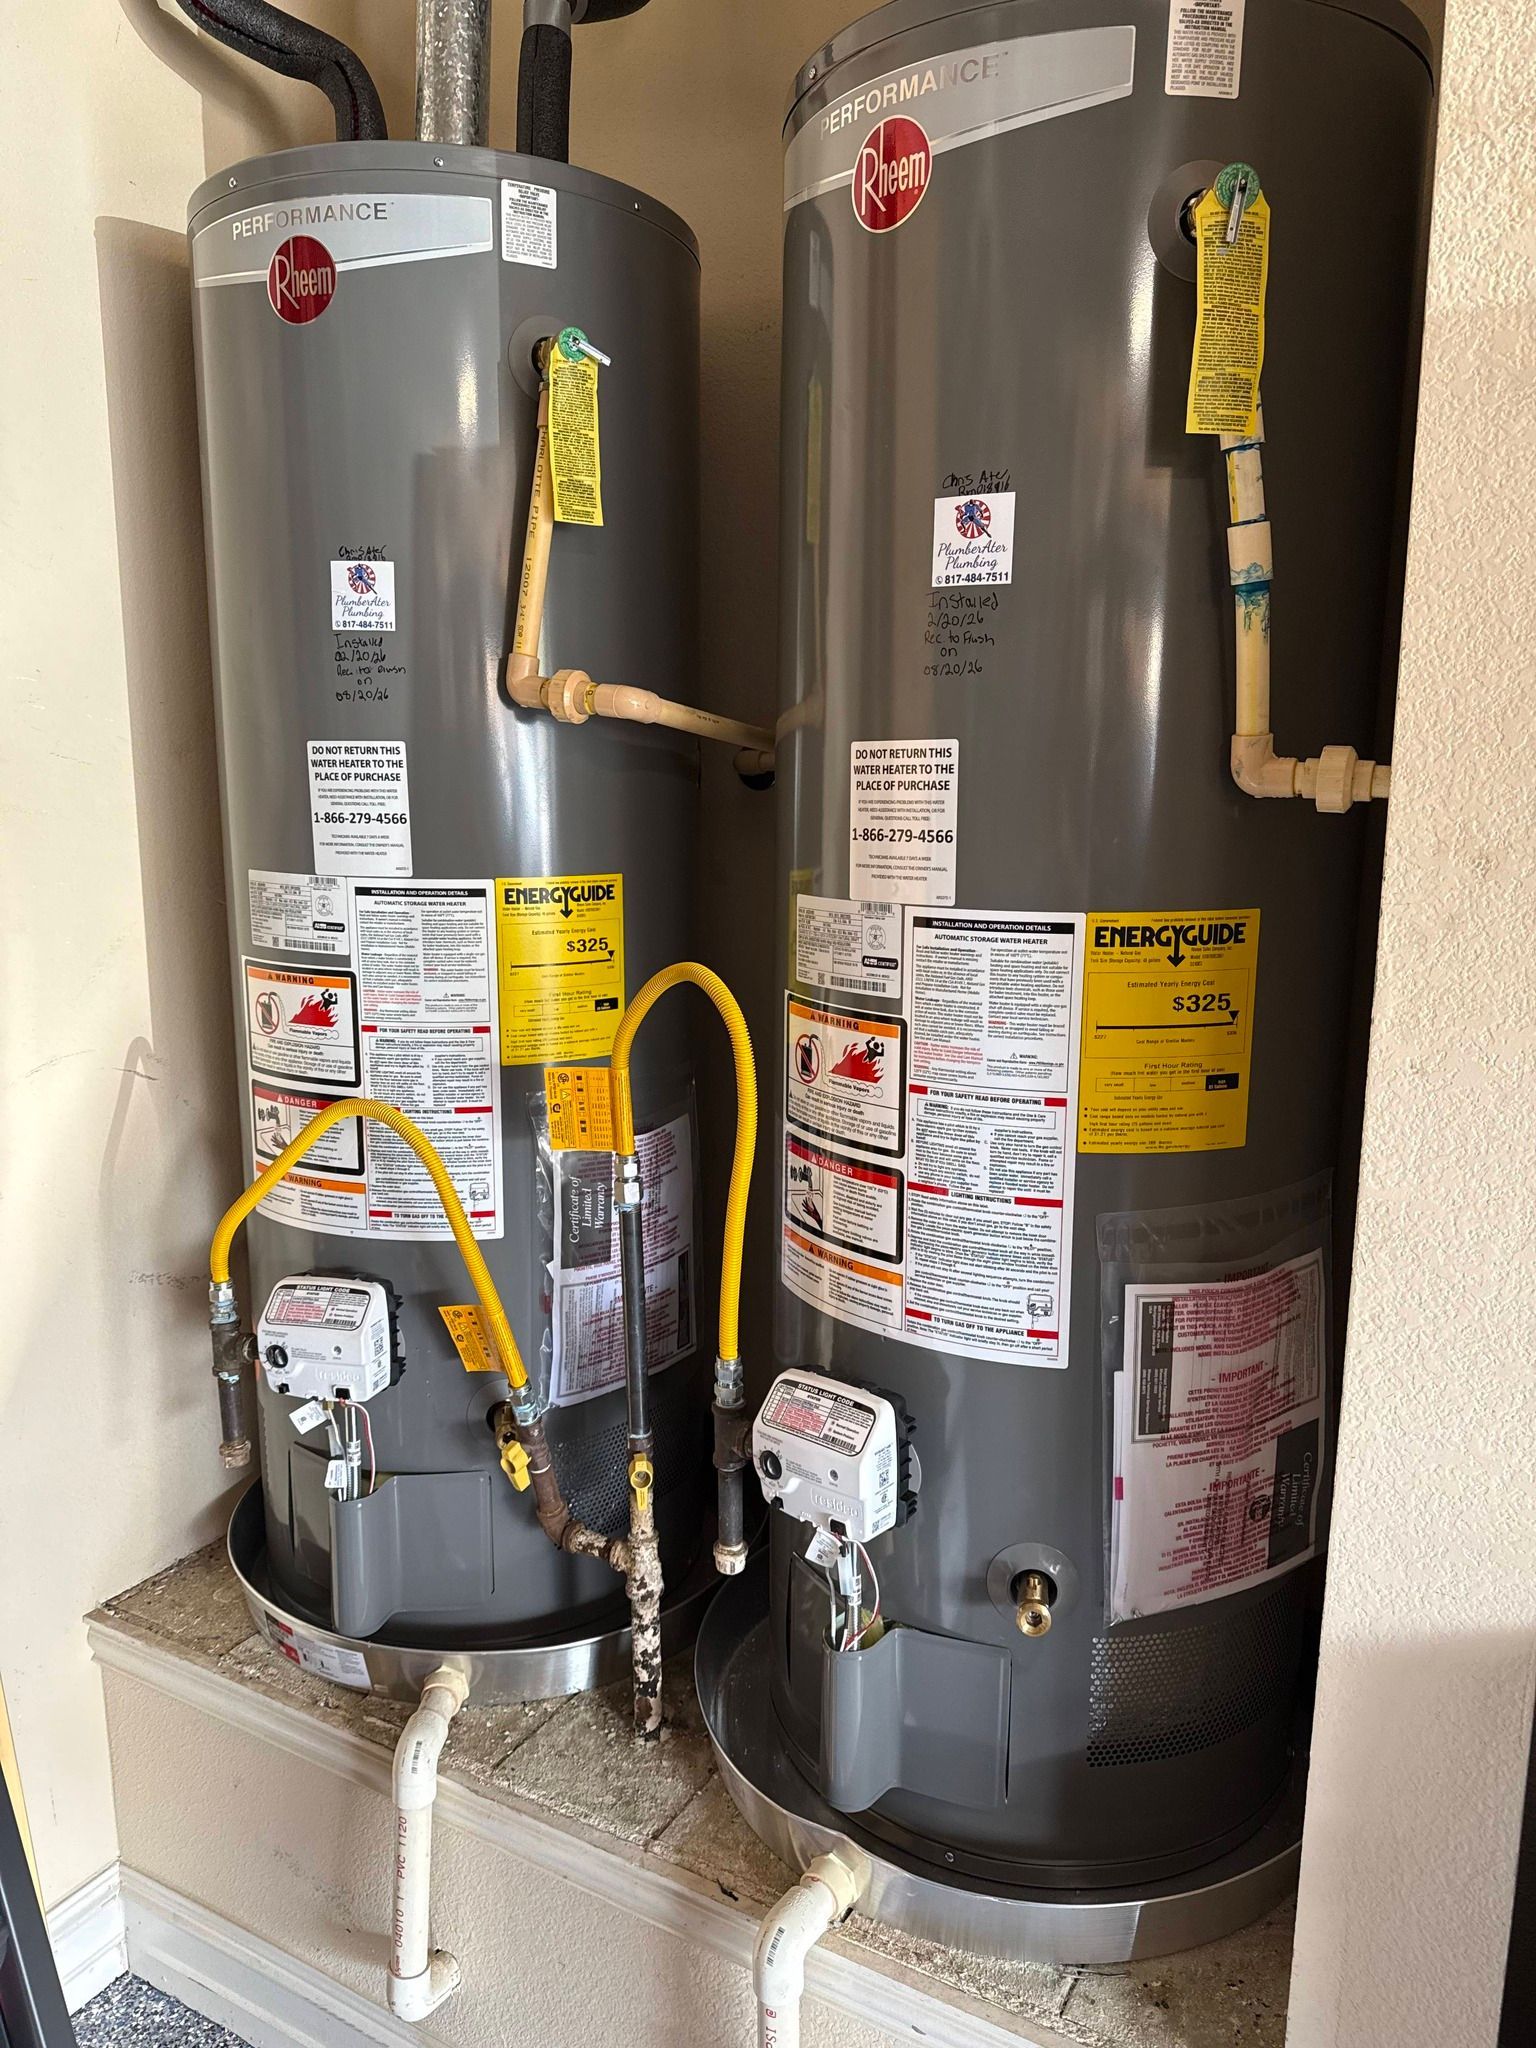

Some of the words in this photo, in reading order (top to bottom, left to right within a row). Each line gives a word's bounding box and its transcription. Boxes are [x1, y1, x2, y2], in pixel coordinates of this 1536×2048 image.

[861, 122, 926, 216] Rheem
[274, 237, 332, 309] Rheem
[528, 505, 539, 539] PIPE
[937, 540, 1008, 557] PlumberAter
[945, 555, 998, 571] Plumbing
[522, 557, 532, 597] 12007
[944, 572, 1009, 584] 817-484-7511
[335, 595, 391, 606] PlumberAter
[926, 591, 998, 610] Installed
[342, 605, 384, 620] Plumbing
[927, 611, 984, 629] 2/20/26
[342, 620, 393, 630] 817-484-7511
[333, 633, 383, 649] Installed
[948, 630, 960, 644] to
[335, 648, 386, 664] 02/20/26
[940, 647, 958, 657] on
[923, 659, 983, 676] 08/20/26
[357, 677, 372, 685] on
[336, 688, 389, 702] 08/20/26
[312, 746, 324, 755] DO
[325, 746, 342, 755] NOT
[344, 746, 379, 755] RETURN
[381, 746, 401, 755] THIS
[855, 749, 868, 760] DO
[869, 749, 887, 760] NOT
[889, 748, 927, 759] RETURN
[929, 747, 952, 758] THIS
[310, 759, 338, 768] WATER
[339, 759, 371, 768] HEATER
[373, 760, 385, 768] TO
[386, 760, 404, 768] THE
[853, 764, 881, 775] WATER
[882, 764, 917, 774] HEATER
[919, 764, 933, 774] TO
[935, 763, 954, 774] THE
[315, 772, 340, 781] PLACE
[341, 773, 352, 781] OF
[354, 773, 401, 781] PURCHASE
[856, 781, 882, 791] PLACE
[883, 780, 896, 791] OF
[898, 780, 950, 791] PURCHASE
[313, 812, 408, 824] 1-866-279-4566
[852, 828, 954, 843] 1-866-279-4566
[504, 884, 616, 905] ENERGYGUIDE
[932, 920, 973, 929] INSTALLATION
[973, 922, 987, 930] AND
[988, 922, 1024, 931] OPERATION
[1025, 923, 1052, 932] DETAILS
[934, 933, 969, 942] AUTOMATIC
[970, 935, 999, 944] STORAGE
[1000, 936, 1022, 944] WATER
[1023, 937, 1049, 945] HEATER
[1094, 922, 1247, 948] ENERGYGUIDE
[566, 937, 609, 953] $325
[275, 974, 315, 985] WARNING
[1180, 980, 1201, 988] Energy
[1172, 993, 1231, 1013] $325
[818, 1014, 860, 1031] WARNING
[312, 1029, 328, 1037] Vapors
[853, 1085, 870, 1093] Vapors
[955, 1092, 973, 1100] SAFETY
[284, 1096, 318, 1108] DANGER
[818, 1157, 853, 1176] DANGER
[288, 1175, 323, 1188] WARNING
[569, 1175, 581, 1187] of
[594, 1182, 607, 1229] Warranty
[951, 1192, 974, 1200] LIGHTING
[975, 1195, 1012, 1204] INSTRUCTIONS
[582, 1188, 592, 1227] Limited
[569, 1189, 581, 1243] Certificate
[818, 1249, 854, 1270] WARNING
[995, 1327, 1025, 1336] APPLIANCE
[1218, 1360, 1264, 1383] IMPORTANT
[797, 1383, 818, 1394] STATUS
[819, 1389, 836, 1401] LIGHT
[837, 1396, 855, 1407] CODE
[1299, 1452, 1313, 1512] Certificate
[1295, 1515, 1305, 1527] of
[399, 1816, 407, 1846] 1120
[396, 1855, 406, 1879] PVC
[395, 1909, 404, 1948] 04010
